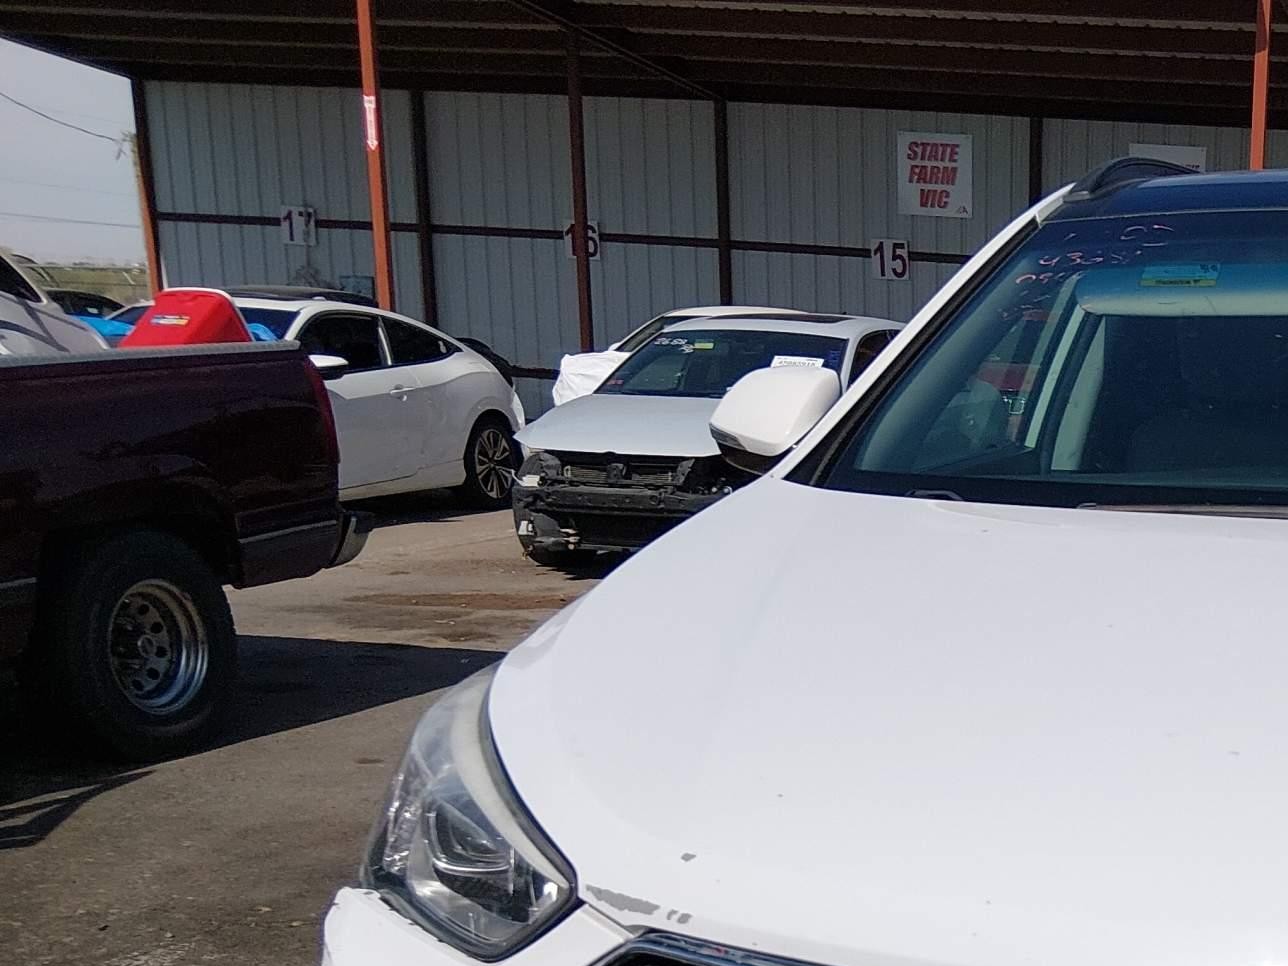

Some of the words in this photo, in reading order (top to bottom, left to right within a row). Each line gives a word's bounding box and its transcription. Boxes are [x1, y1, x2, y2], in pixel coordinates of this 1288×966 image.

[907, 141, 960, 162] STATE
[908, 164, 958, 185] FARM
[919, 188, 950, 208] VIC
[874, 241, 907, 278] 15
